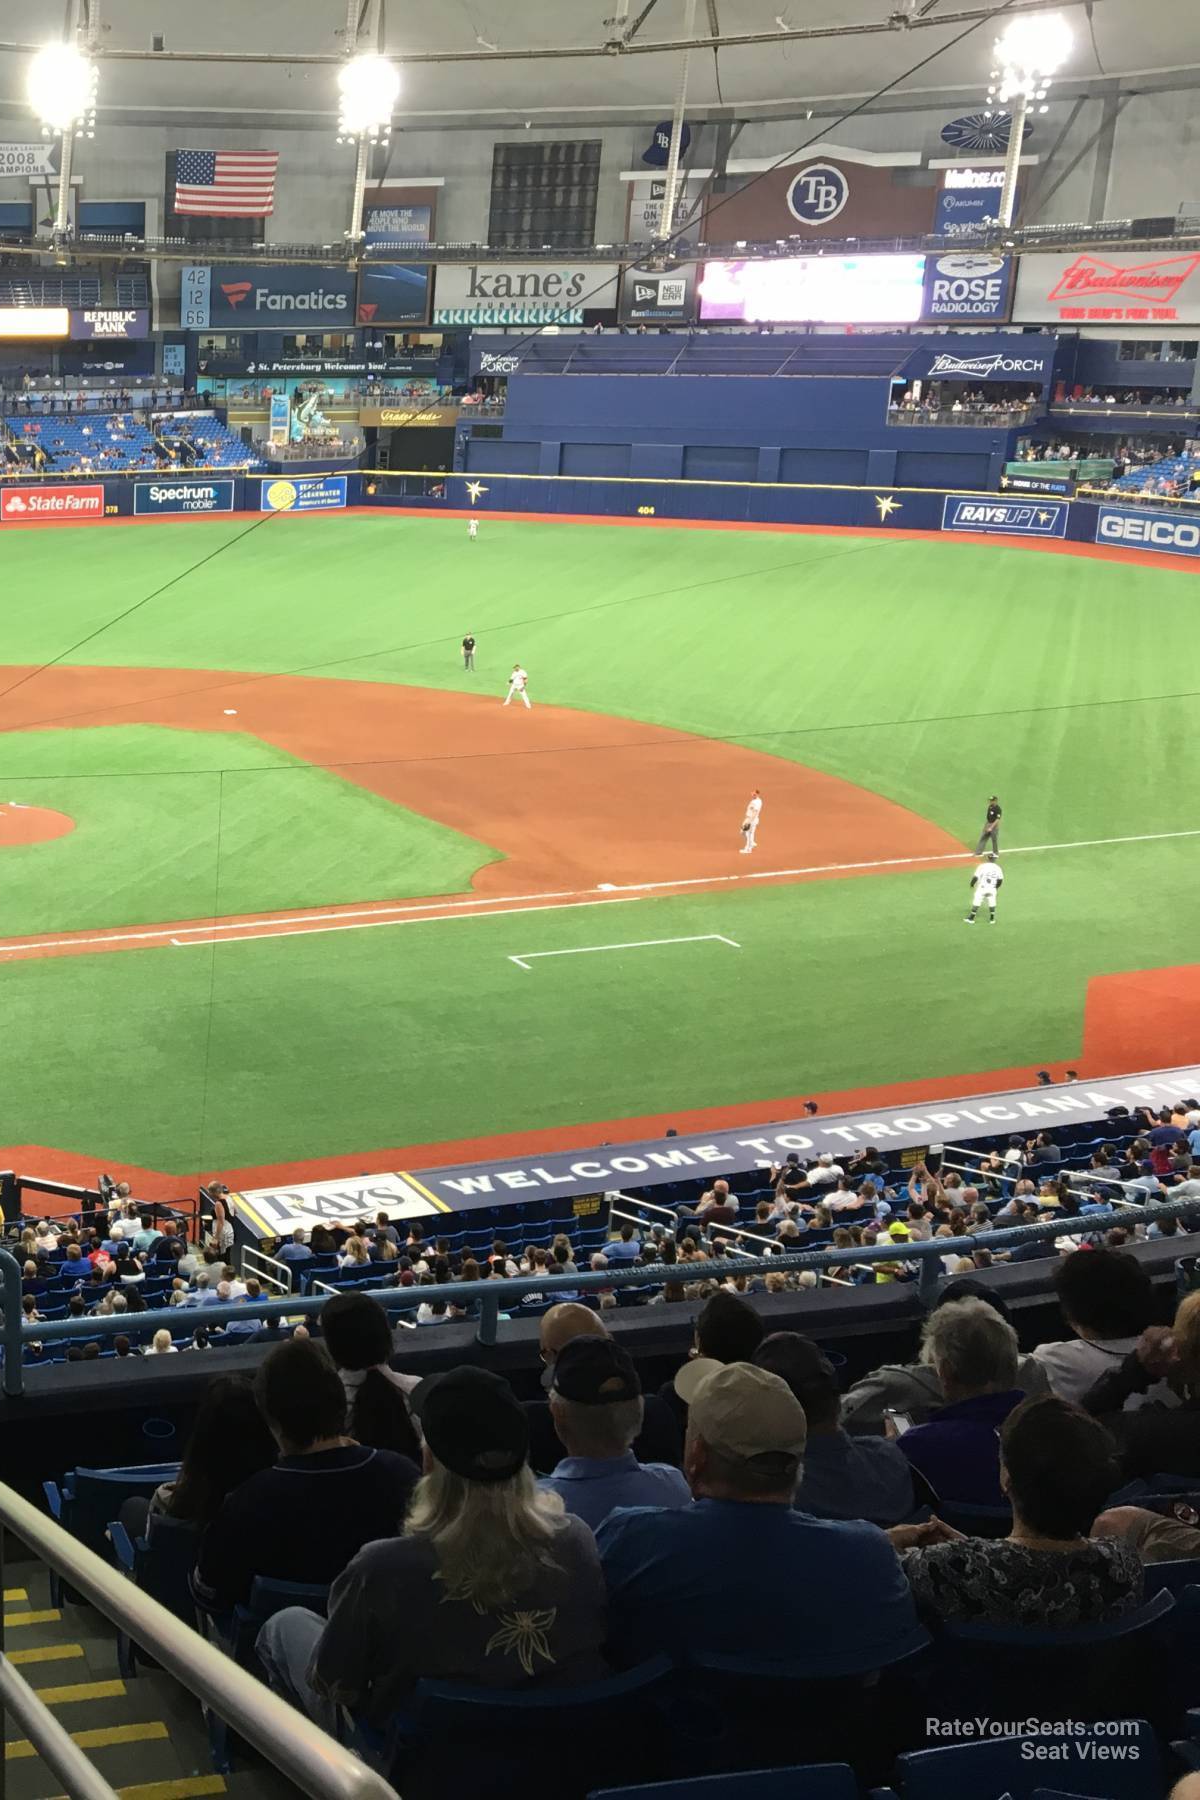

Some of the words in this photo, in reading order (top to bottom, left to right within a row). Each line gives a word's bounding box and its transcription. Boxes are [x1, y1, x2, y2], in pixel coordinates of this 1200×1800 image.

[657, 132, 669, 148] TB
[800, 176, 837, 213] TB
[401, 209, 413, 217] THE
[402, 224, 424, 232] WORLD
[187, 270, 205, 284] 42
[466, 266, 585, 298] kane's
[662, 285, 682, 293] NEW
[933, 280, 1001, 300] ROSE
[190, 290, 203, 304] 12
[255, 288, 347, 311] Fanatics
[931, 302, 998, 313] RADIOLOGY
[84, 311, 136, 322] REPUBLIC
[187, 310, 204, 324] 66
[94, 322, 126, 332] BANK
[258, 362, 270, 371] St.
[272, 362, 322, 373] Petersburg
[324, 362, 366, 371] Welcomes
[367, 361, 387, 371] You!
[481, 362, 519, 372] PORCH
[936, 357, 994, 370] Budweiser
[995, 359, 1043, 371] PORCH
[1031, 481, 1039, 489] OF
[1040, 482, 1050, 490] THE
[150, 486, 213, 501] Spectrum
[106, 505, 118, 514] 378
[183, 499, 214, 510] mobile
[638, 506, 655, 515] 404
[1101, 515, 1200, 548] GEICO
[440, 1145, 732, 1196] WELCOME
[738, 1133, 815, 1155] TO
[823, 1090, 1127, 1145] TROPICANA
[255, 1186, 407, 1223] RAYS
